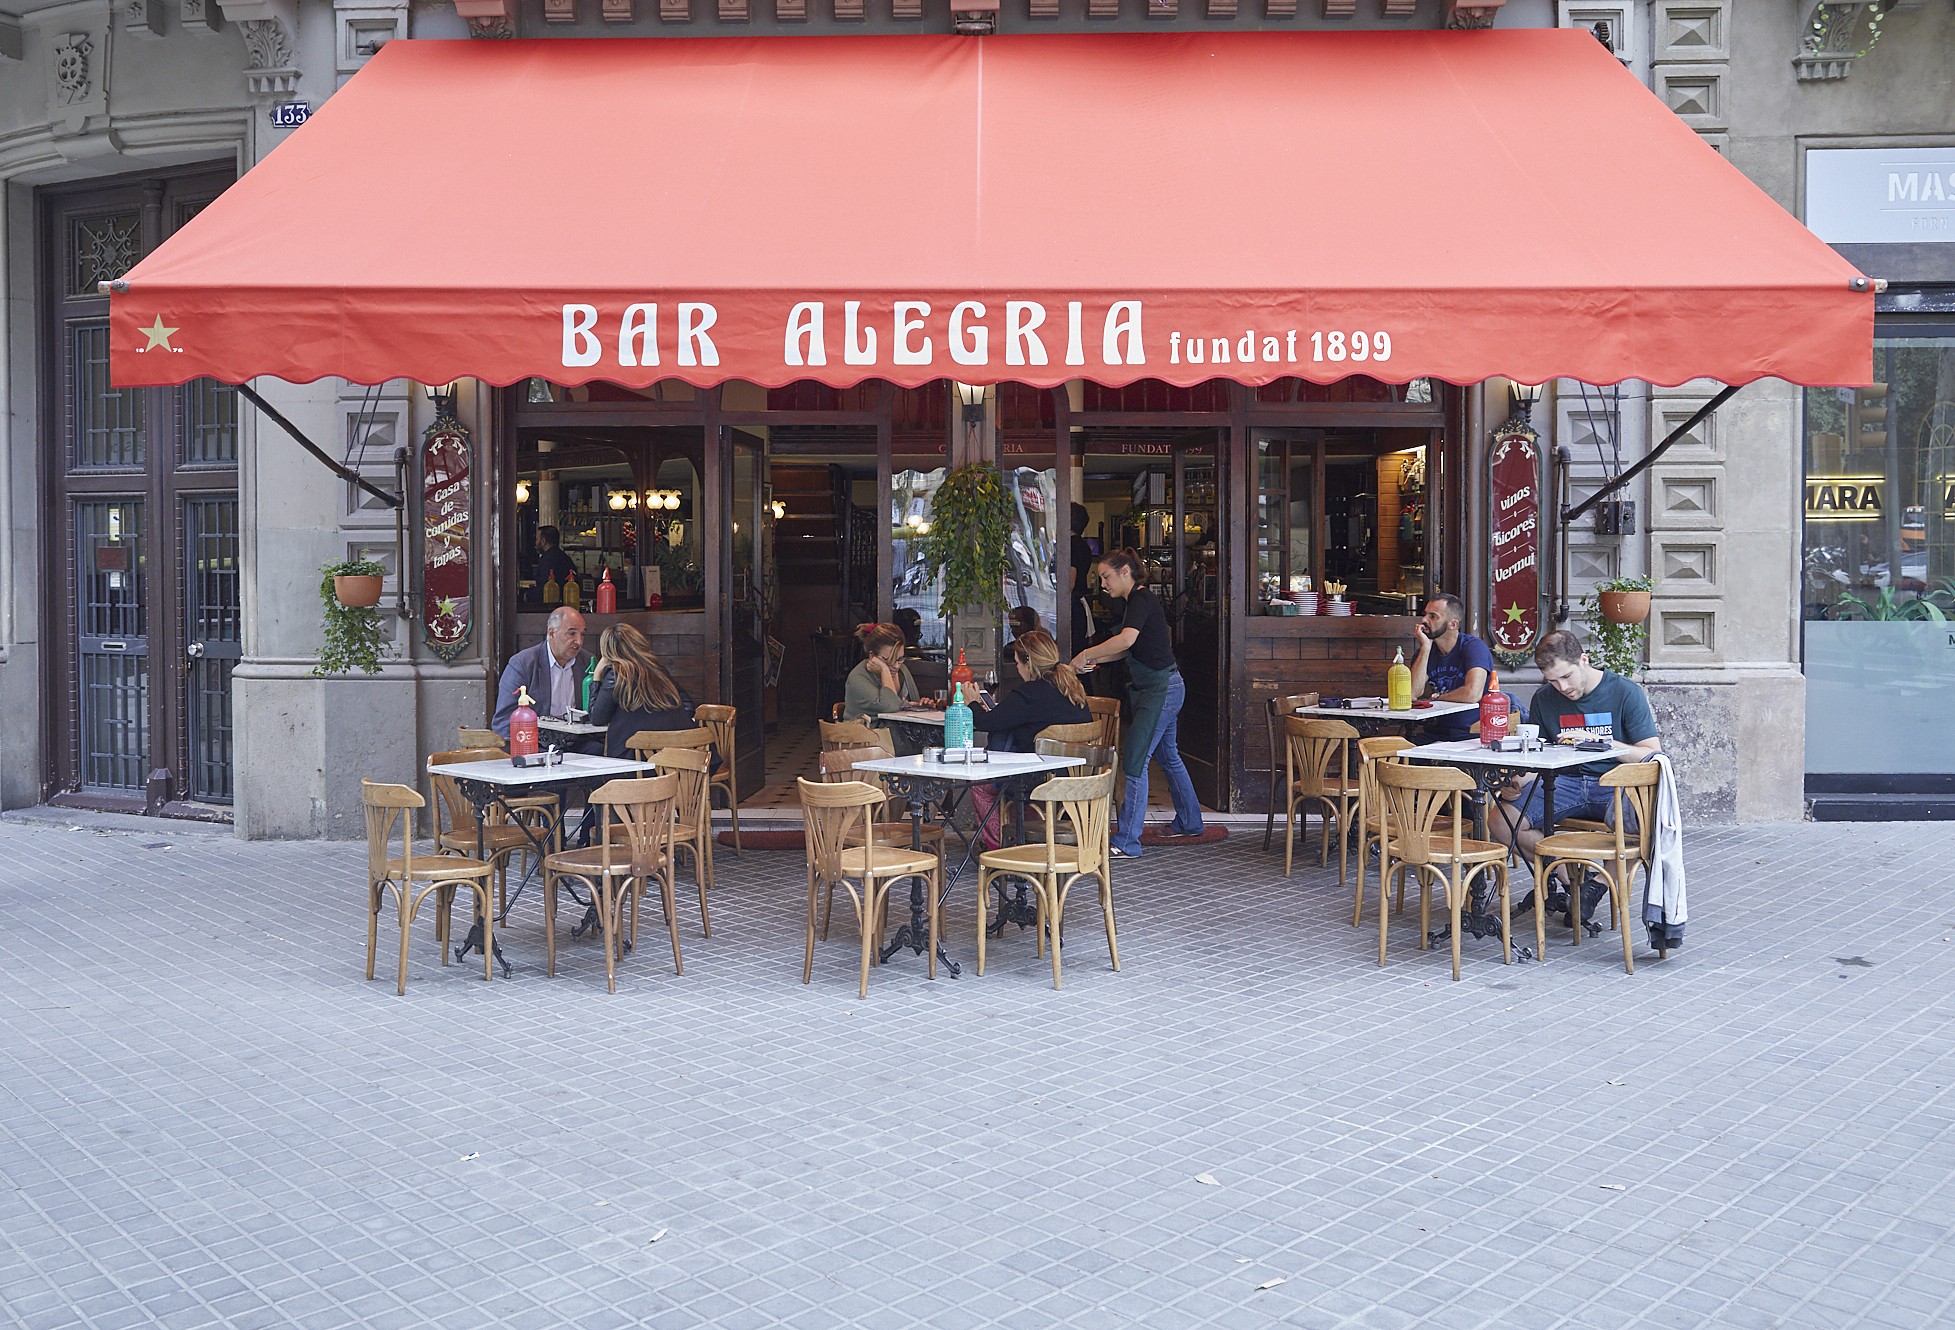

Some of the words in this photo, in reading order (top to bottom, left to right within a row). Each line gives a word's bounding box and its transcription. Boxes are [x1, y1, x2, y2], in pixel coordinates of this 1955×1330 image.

[275, 104, 307, 124] 133
[561, 302, 721, 367] BAR
[784, 300, 1147, 366] ALEGRIA
[1169, 329, 1298, 364] fundat
[1310, 330, 1392, 362] 1899
[1121, 444, 1171, 454] FUNDAT
[434, 481, 460, 503] Casa
[440, 501, 454, 516] de
[425, 511, 469, 538] comidas
[1493, 518, 1536, 547] Licores
[443, 535, 451, 548] y
[433, 545, 462, 569] tapas
[1495, 552, 1536, 583] Vermut
[1585, 725, 1613, 736] SHORES
